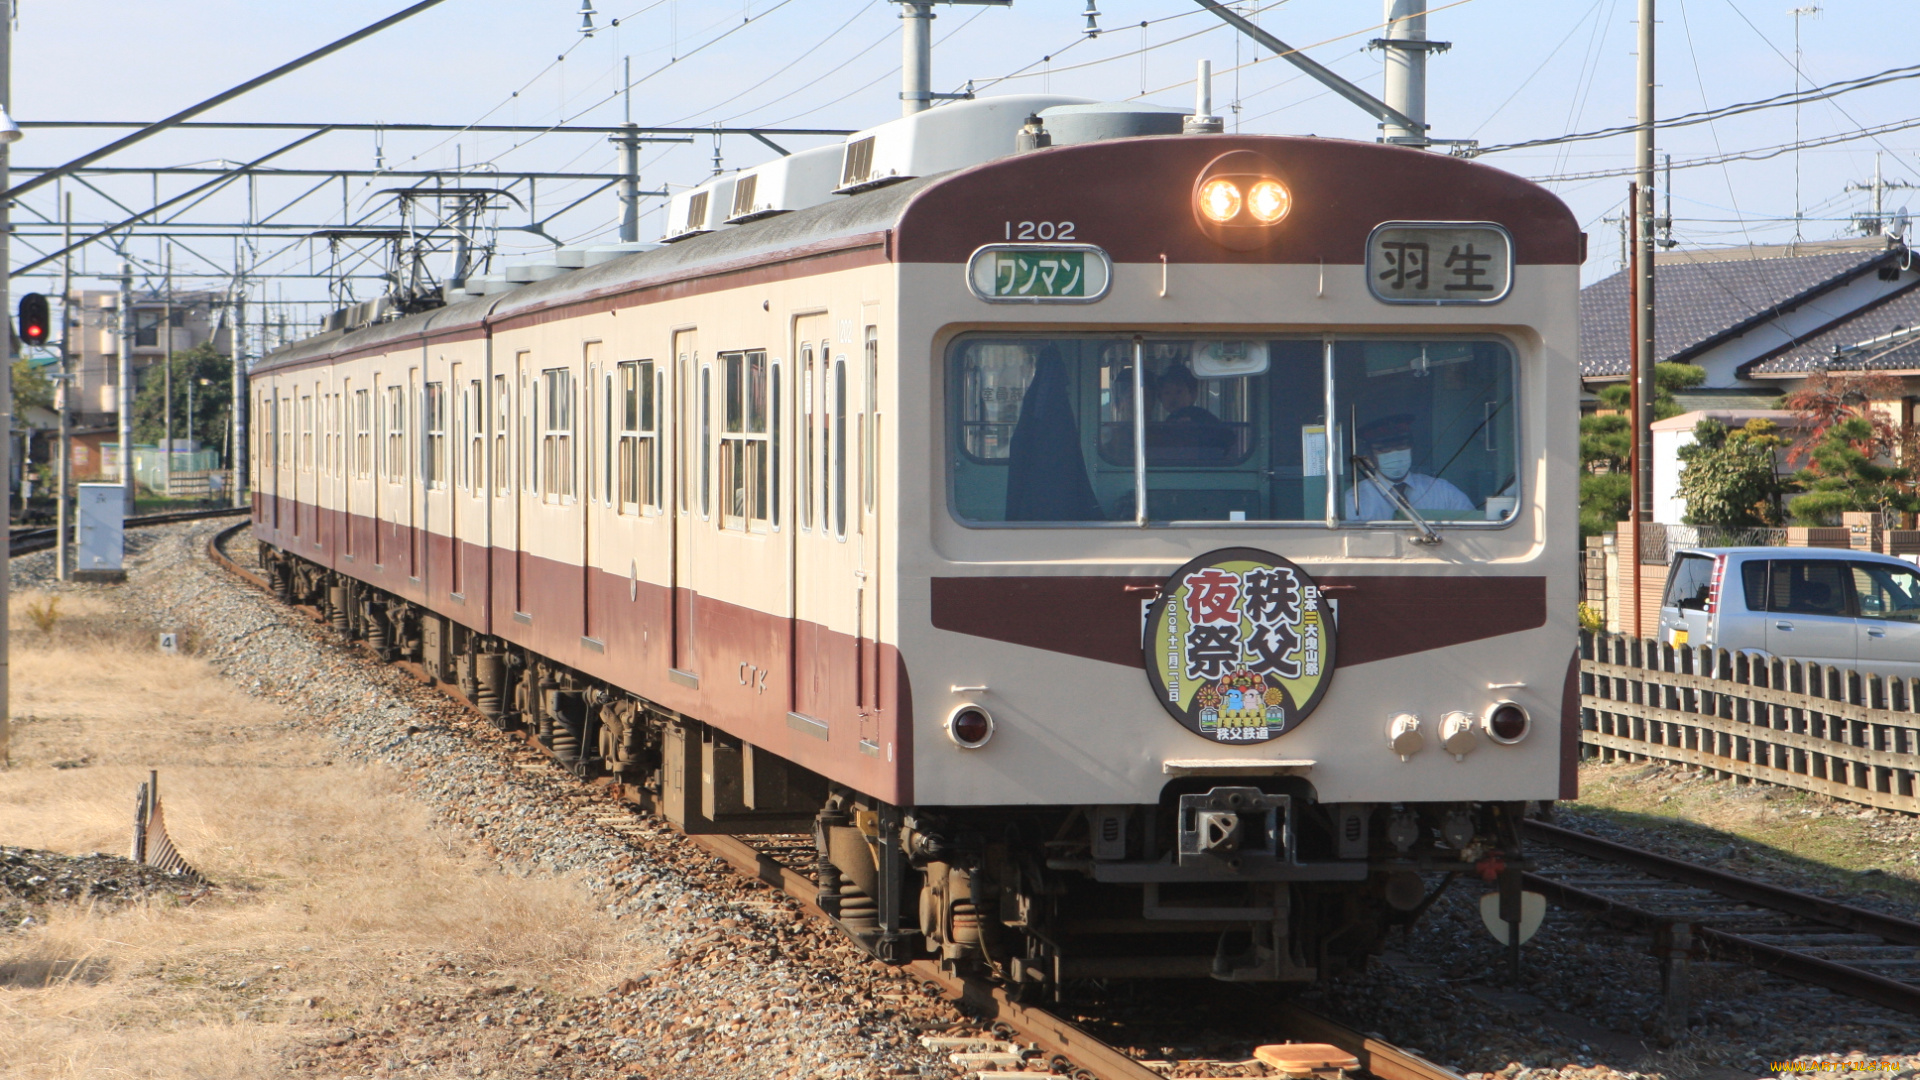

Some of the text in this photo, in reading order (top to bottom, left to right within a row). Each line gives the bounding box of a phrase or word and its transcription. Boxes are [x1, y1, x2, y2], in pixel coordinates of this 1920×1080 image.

[1005, 221, 1076, 240] 1202
[1379, 241, 1494, 292] 羽生
[997, 258, 1081, 295] ワンマン
[162, 637, 172, 648] 4
[1216, 727, 1269, 740] 秩父鉄道
